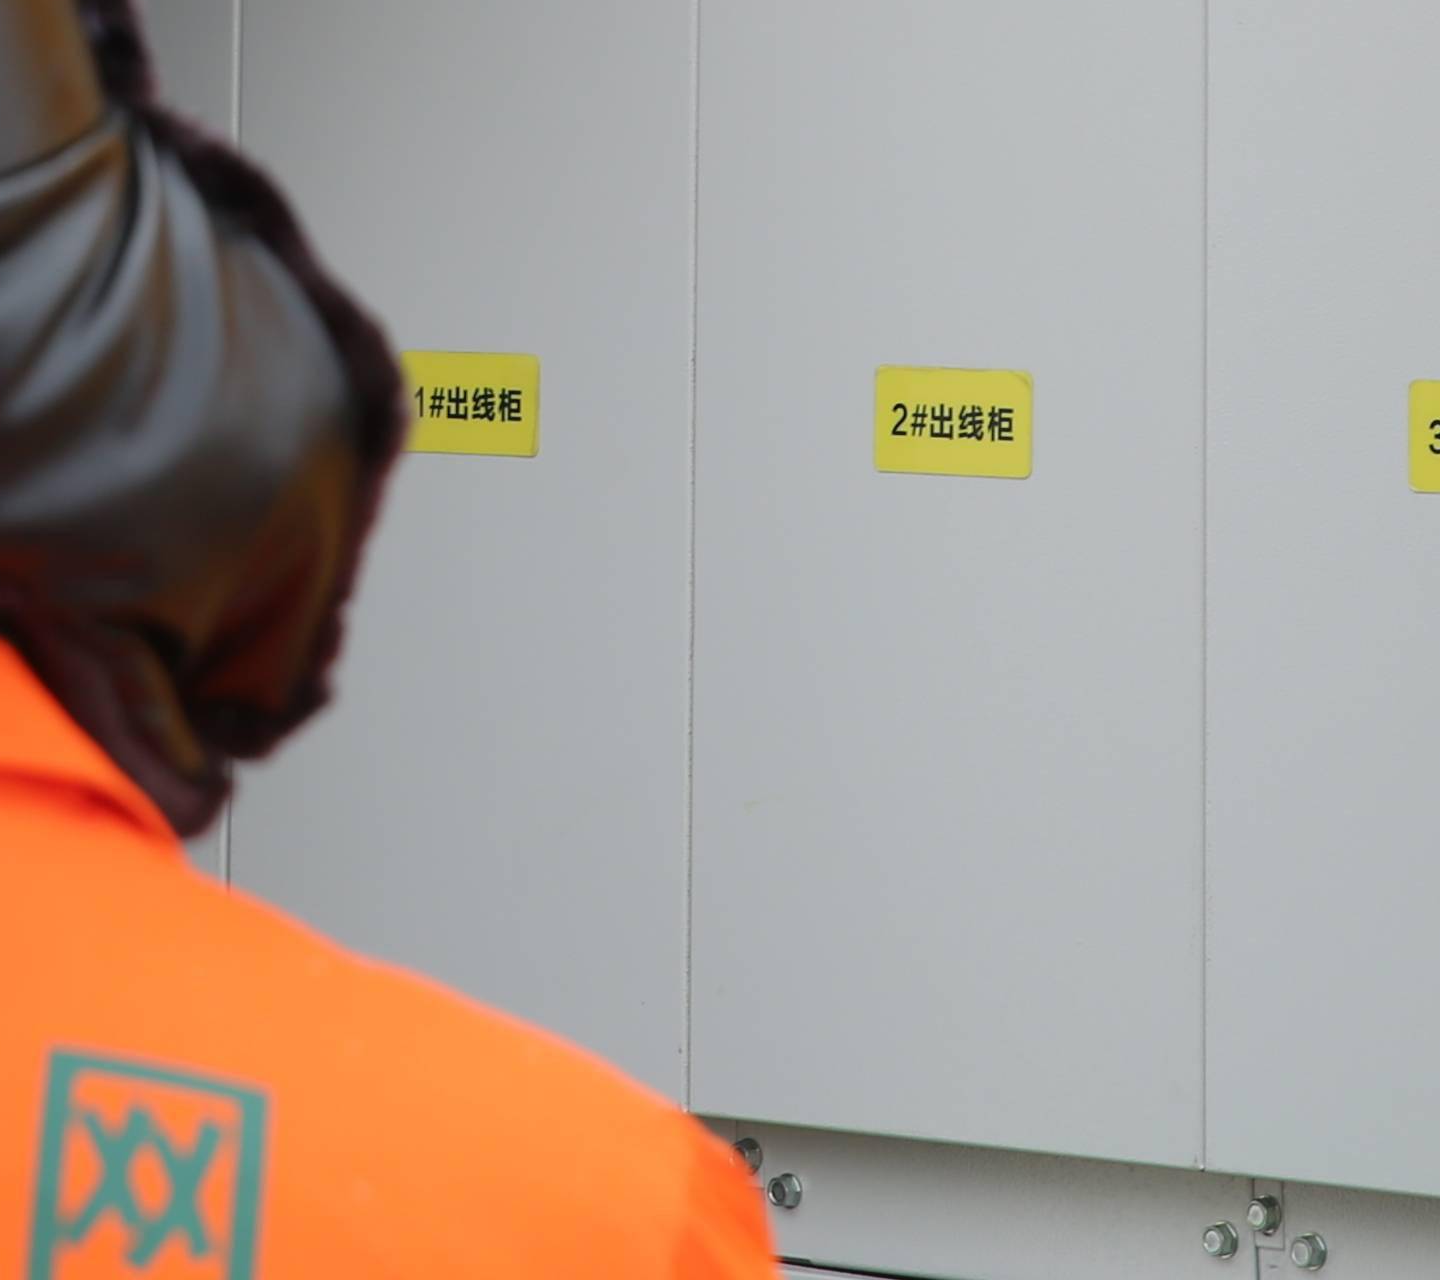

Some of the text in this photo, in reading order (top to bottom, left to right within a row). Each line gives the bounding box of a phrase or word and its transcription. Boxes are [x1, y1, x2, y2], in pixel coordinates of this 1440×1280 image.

[414, 386, 523, 423] 1#出线柜
[891, 402, 1014, 442] 2#出线柜
